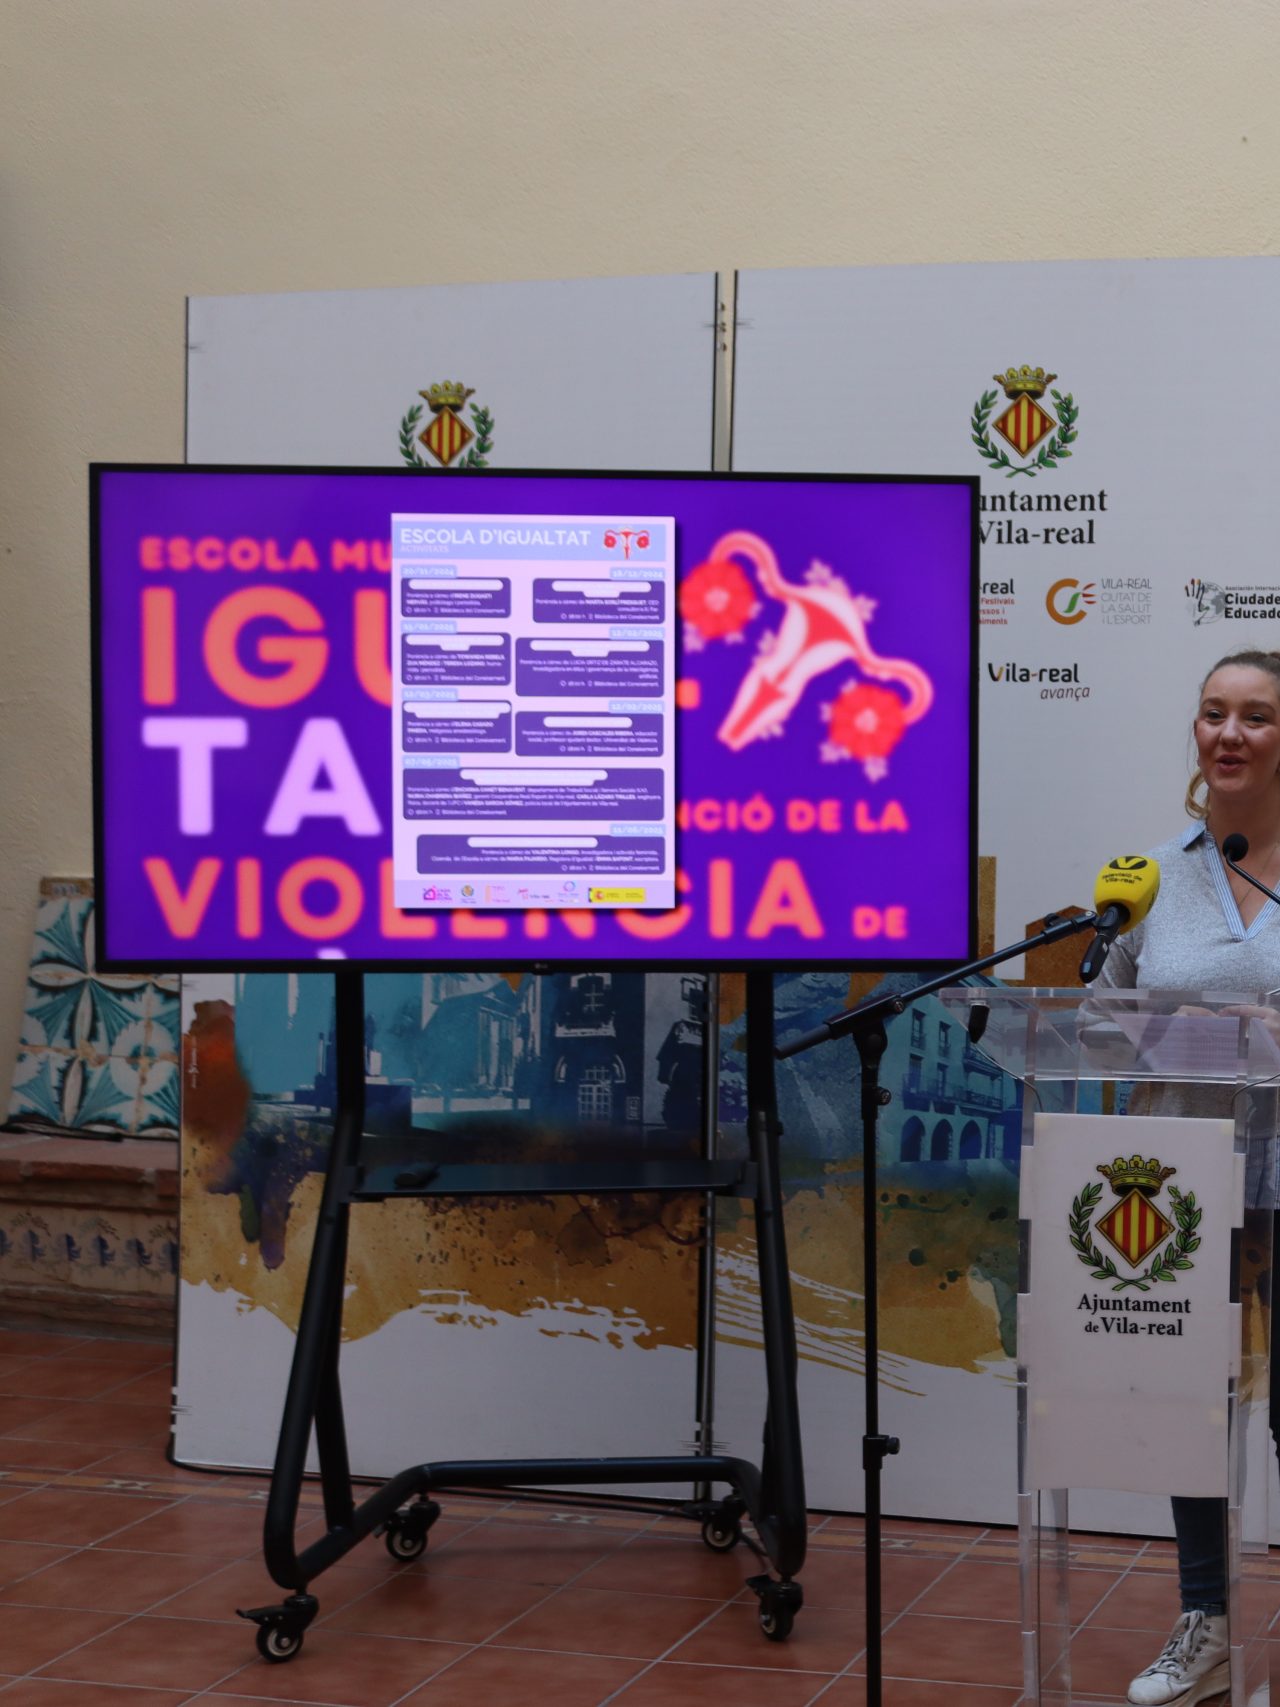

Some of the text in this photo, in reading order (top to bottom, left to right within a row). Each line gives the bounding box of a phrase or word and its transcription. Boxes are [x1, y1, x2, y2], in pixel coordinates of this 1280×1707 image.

[400, 528, 592, 546] ESCOLA D'IGUALTAT
[142, 537, 391, 573] ESCOLA MU
[1101, 578, 1152, 590] VILA-REAL
[988, 662, 1080, 683] Vila-real
[1041, 686, 1091, 701] avança
[143, 717, 382, 836] TA
[787, 799, 842, 833] DE
[855, 800, 910, 834] LA
[143, 856, 907, 940] VIOLIA DE
[1077, 1293, 1191, 1315] Ajuntament
[1085, 1317, 1183, 1336] de Vila-real
